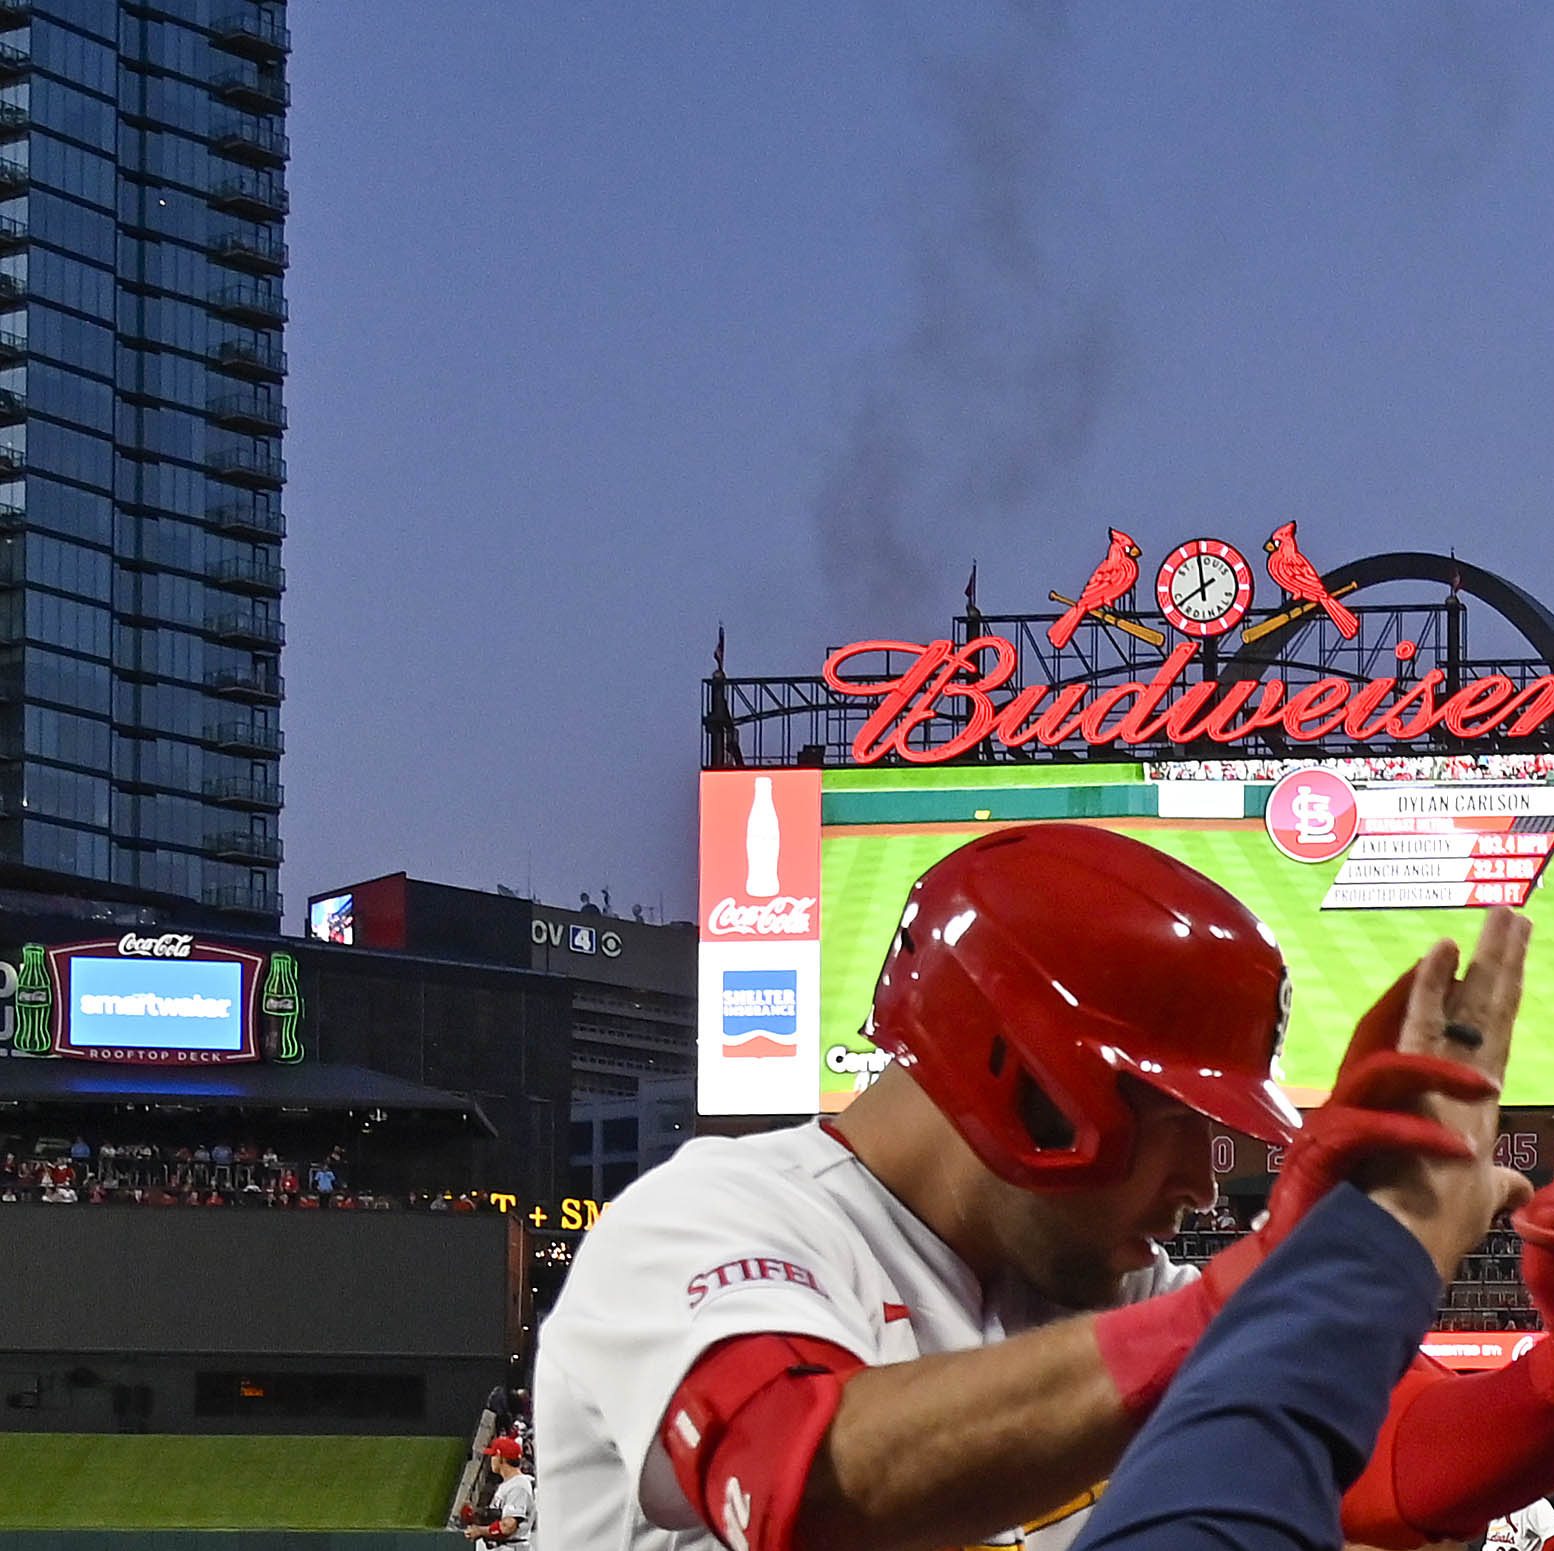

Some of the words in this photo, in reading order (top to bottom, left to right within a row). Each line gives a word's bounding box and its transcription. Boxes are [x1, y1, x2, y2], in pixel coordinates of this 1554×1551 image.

[1198, 556, 1229, 576] OUIS
[1174, 592, 1233, 619] CRDINALS
[1399, 796, 1449, 813] DYLAN
[1454, 793, 1531, 812] CARLSON
[80, 993, 232, 1019] smartwater
[89, 1050, 170, 1061] ROOFTOP
[177, 1051, 222, 1062] DECK
[561, 1197, 614, 1231] SM
[687, 1256, 831, 1309] STIFEL
